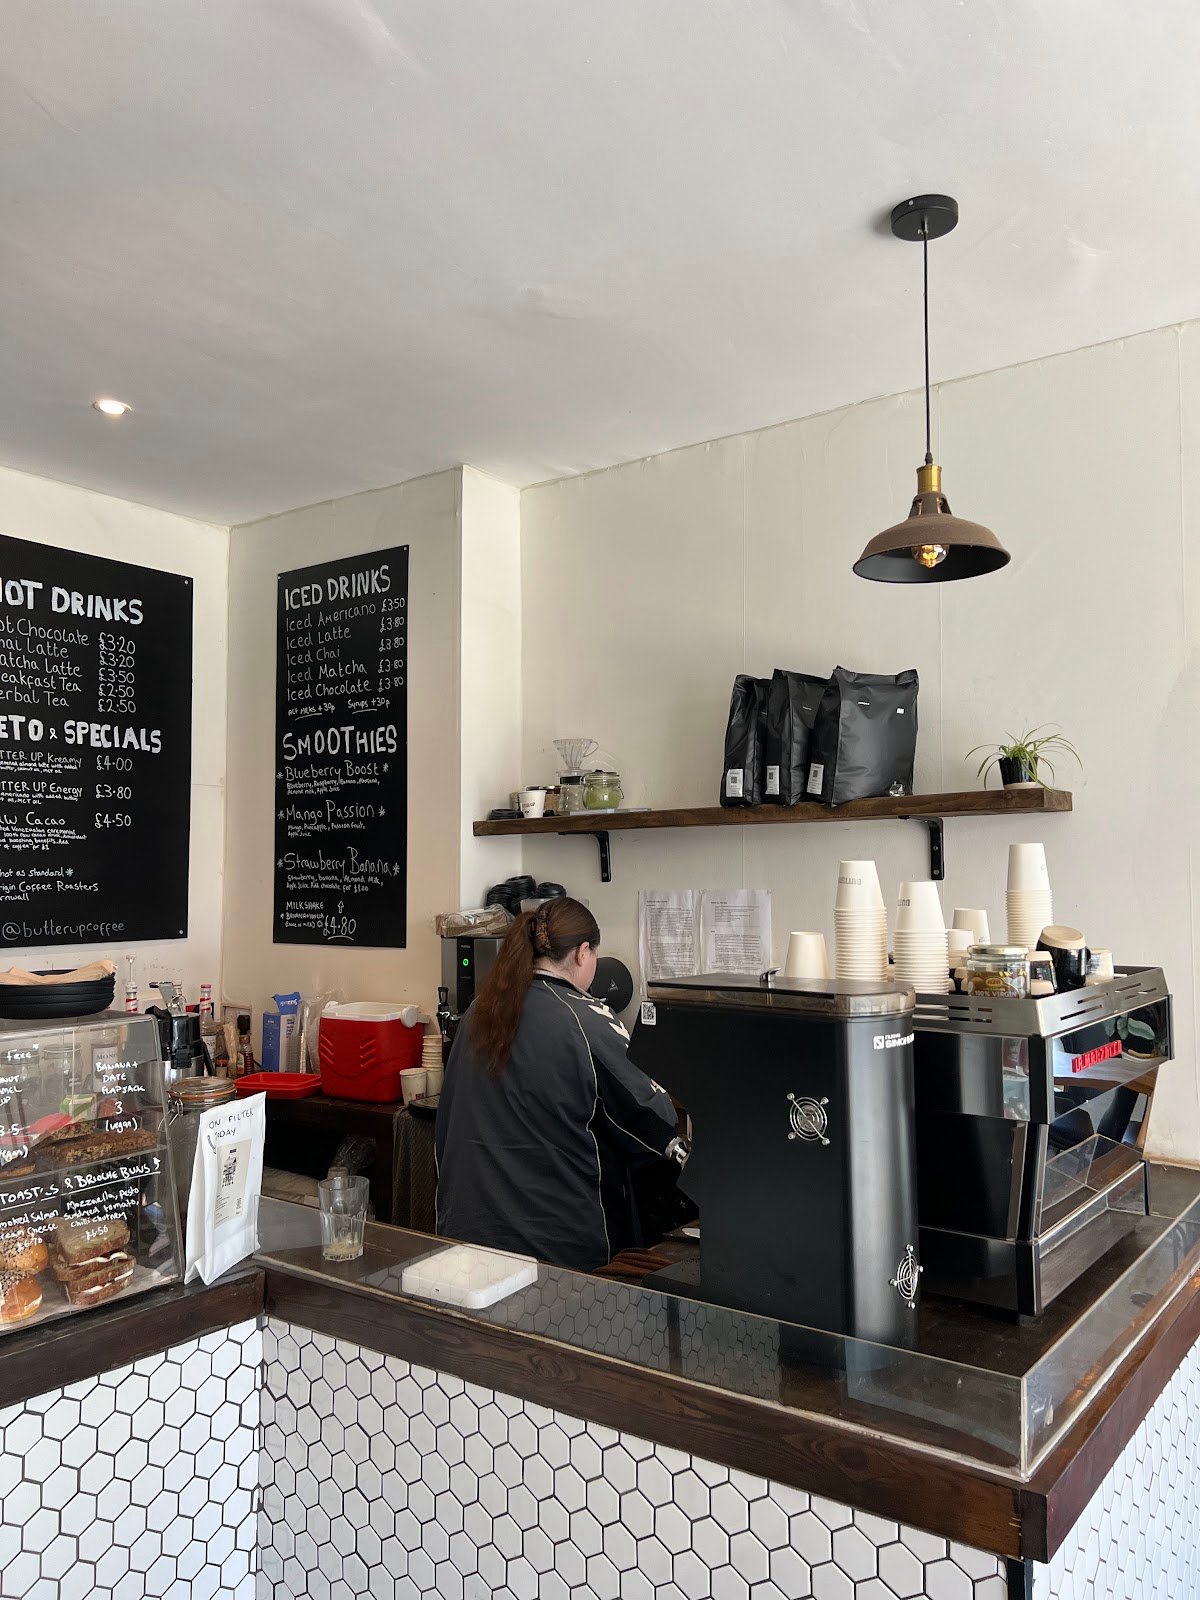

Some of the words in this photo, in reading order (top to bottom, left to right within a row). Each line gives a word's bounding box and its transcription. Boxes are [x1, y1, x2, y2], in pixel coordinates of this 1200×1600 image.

[284, 583, 323, 611] ICED
[326, 564, 391, 602] DRINKS
[0, 577, 43, 610] OT
[51, 586, 144, 625] DRINKS
[286, 612, 313, 633] Iced
[286, 632, 313, 651] Iced
[318, 626, 352, 645] Latte
[380, 616, 405, 633] £3.80
[17, 618, 89, 646] Chocolate
[98, 632, 136, 654] £3.20
[27, 638, 69, 658] Latte
[99, 650, 135, 668] £3.20
[287, 649, 313, 667] Iced
[316, 645, 341, 661] Chai
[379, 637, 405, 653] £3.80
[98, 667, 135, 684] £3.50
[287, 666, 313, 685] Iced
[318, 659, 368, 680] Matcha
[378, 659, 404, 674] £3.80
[1, 670, 57, 689] eakfast
[59, 676, 82, 692] Tea
[98, 683, 135, 698] £2.50
[287, 684, 313, 702] Iced
[315, 678, 373, 697] Chocolate
[378, 676, 405, 693] £3.80
[43, 690, 70, 707] Tea
[97, 699, 137, 713] £2.50
[347, 699, 369, 710] Syrups
[49, 727, 58, 740] &
[63, 720, 162, 754] SPECIALS
[282, 724, 398, 761] SMOOTHIES
[31, 751, 44, 761] UP
[47, 752, 82, 768] Kreamy
[96, 754, 133, 772] £4.00
[285, 763, 341, 782] Blueberry
[344, 759, 380, 777] Boost
[1, 781, 30, 792] TTER
[33, 781, 47, 793] UP
[49, 782, 83, 797] Energy
[95, 784, 132, 800] £3.80
[25, 811, 66, 825] Cacao
[94, 812, 132, 829] £4.50
[286, 803, 323, 826] Mango
[325, 799, 375, 822] Passion
[16, 869, 26, 877] as
[284, 849, 345, 878] Strawberry
[347, 846, 392, 876] Banana
[19, 881, 52, 892] Coffee
[57, 881, 99, 892] Roasters
[286, 901, 324, 910] MILKSHAKE
[2, 918, 125, 941] @butterupcoffee
[323, 915, 357, 936] £4.80
[101, 1084, 146, 1095] FLAPJACK
[103, 1073, 127, 1083] DATE
[115, 1101, 123, 1114] 3
[105, 1117, 138, 1132] (vegan)
[209, 1119, 221, 1129] ON
[0, 1183, 59, 1205] TOASTS
[74, 1171, 119, 1189] BRIOCHE
[120, 1163, 151, 1179] BUNS
[30, 1209, 59, 1222] Salmon
